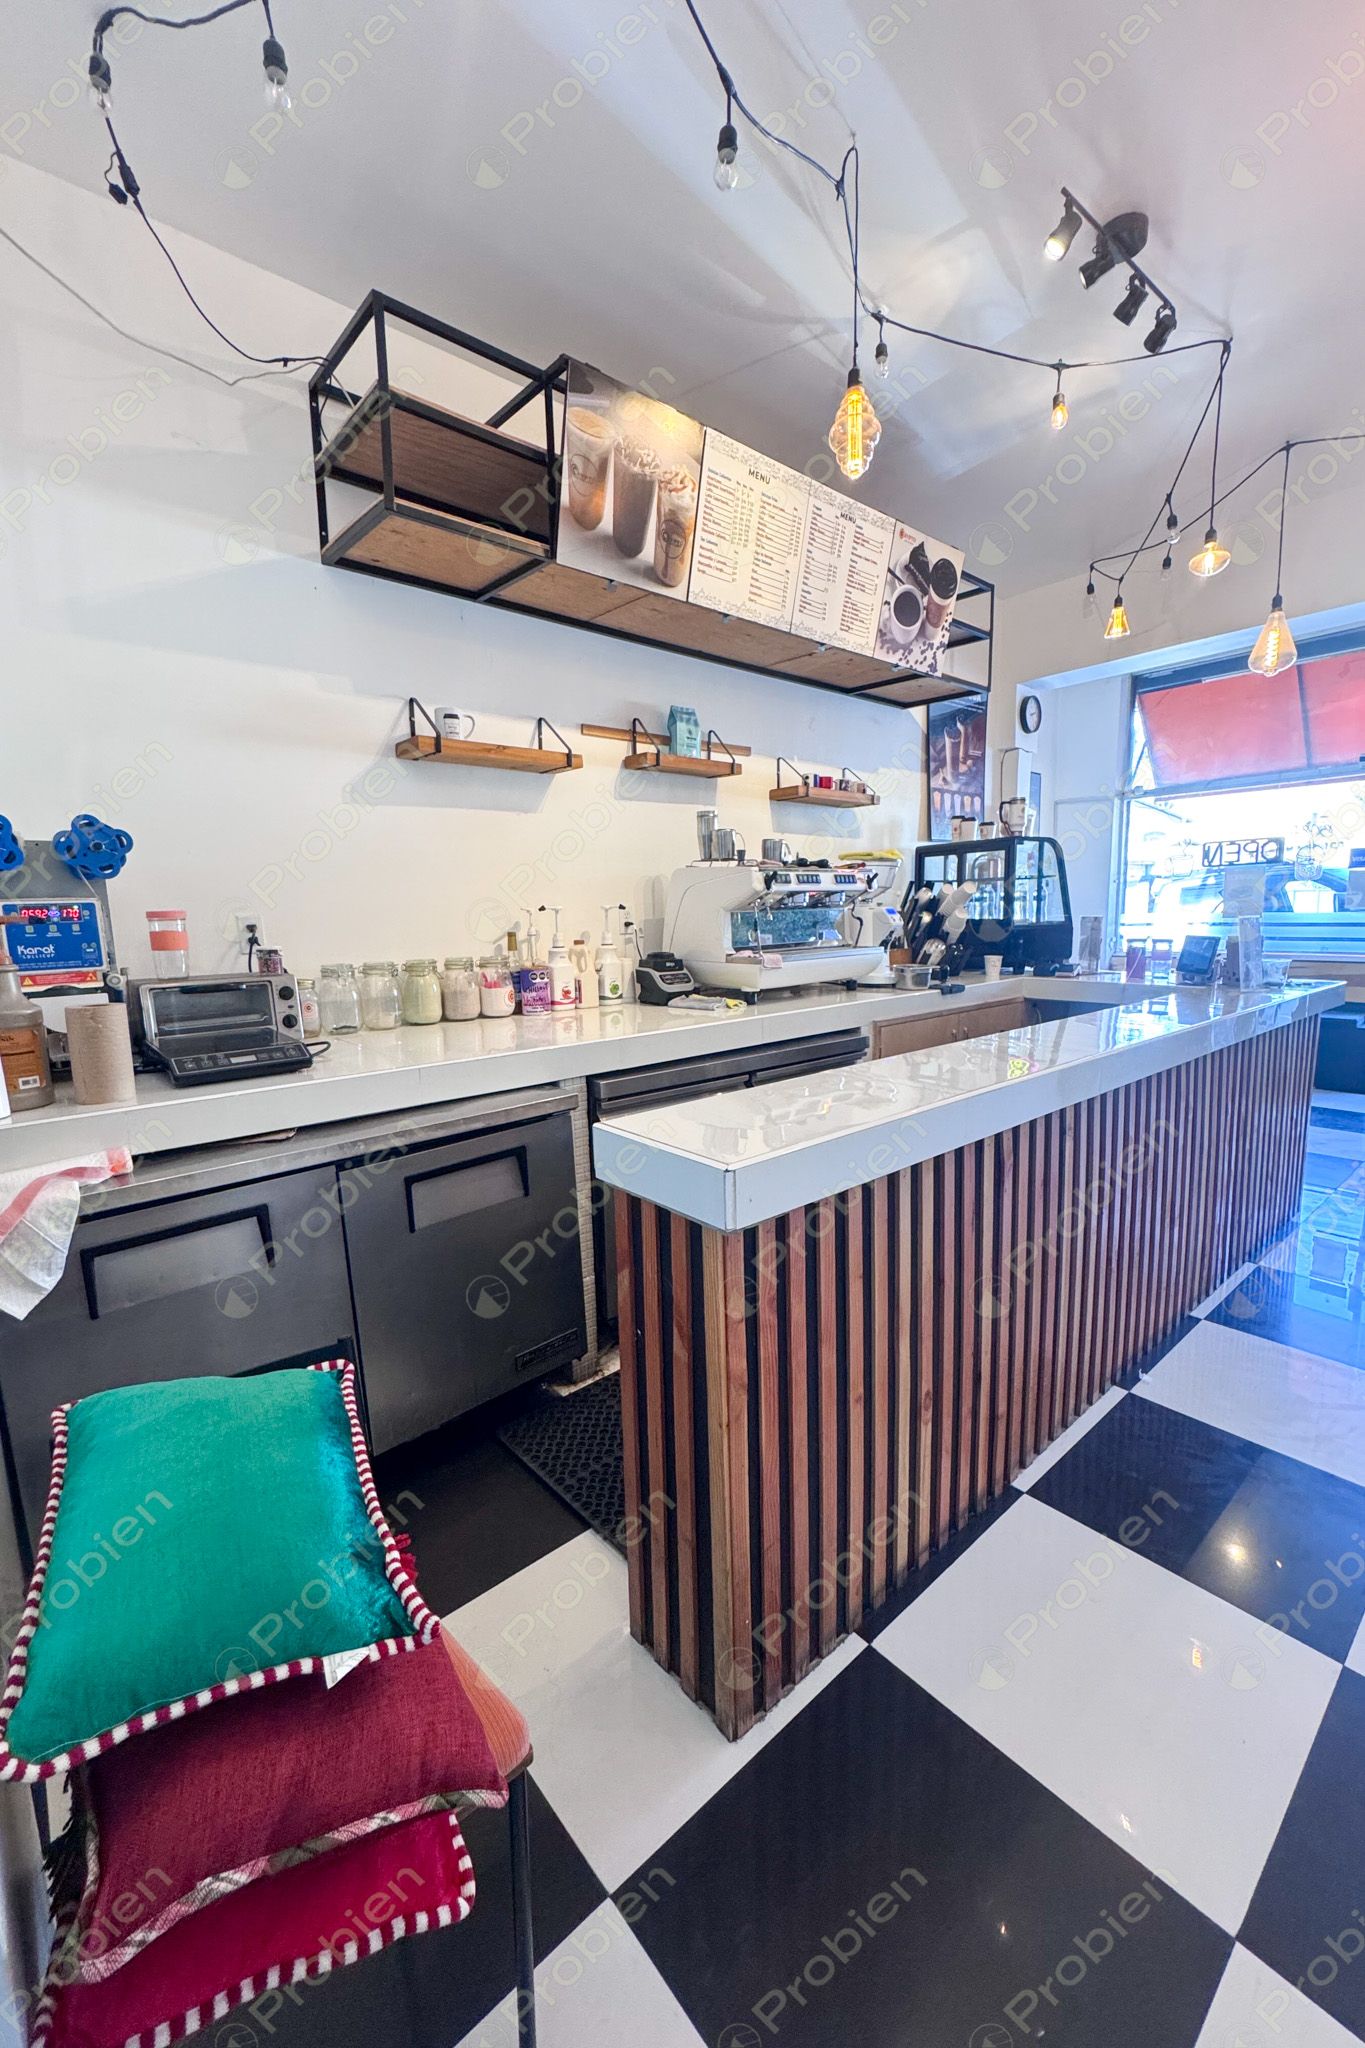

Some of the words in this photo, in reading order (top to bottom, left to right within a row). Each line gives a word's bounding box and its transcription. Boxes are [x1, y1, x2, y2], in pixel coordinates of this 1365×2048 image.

[748, 468, 771, 485] MENU
[840, 511, 857, 525] MENU
[17, 944, 55, 955] Karat
